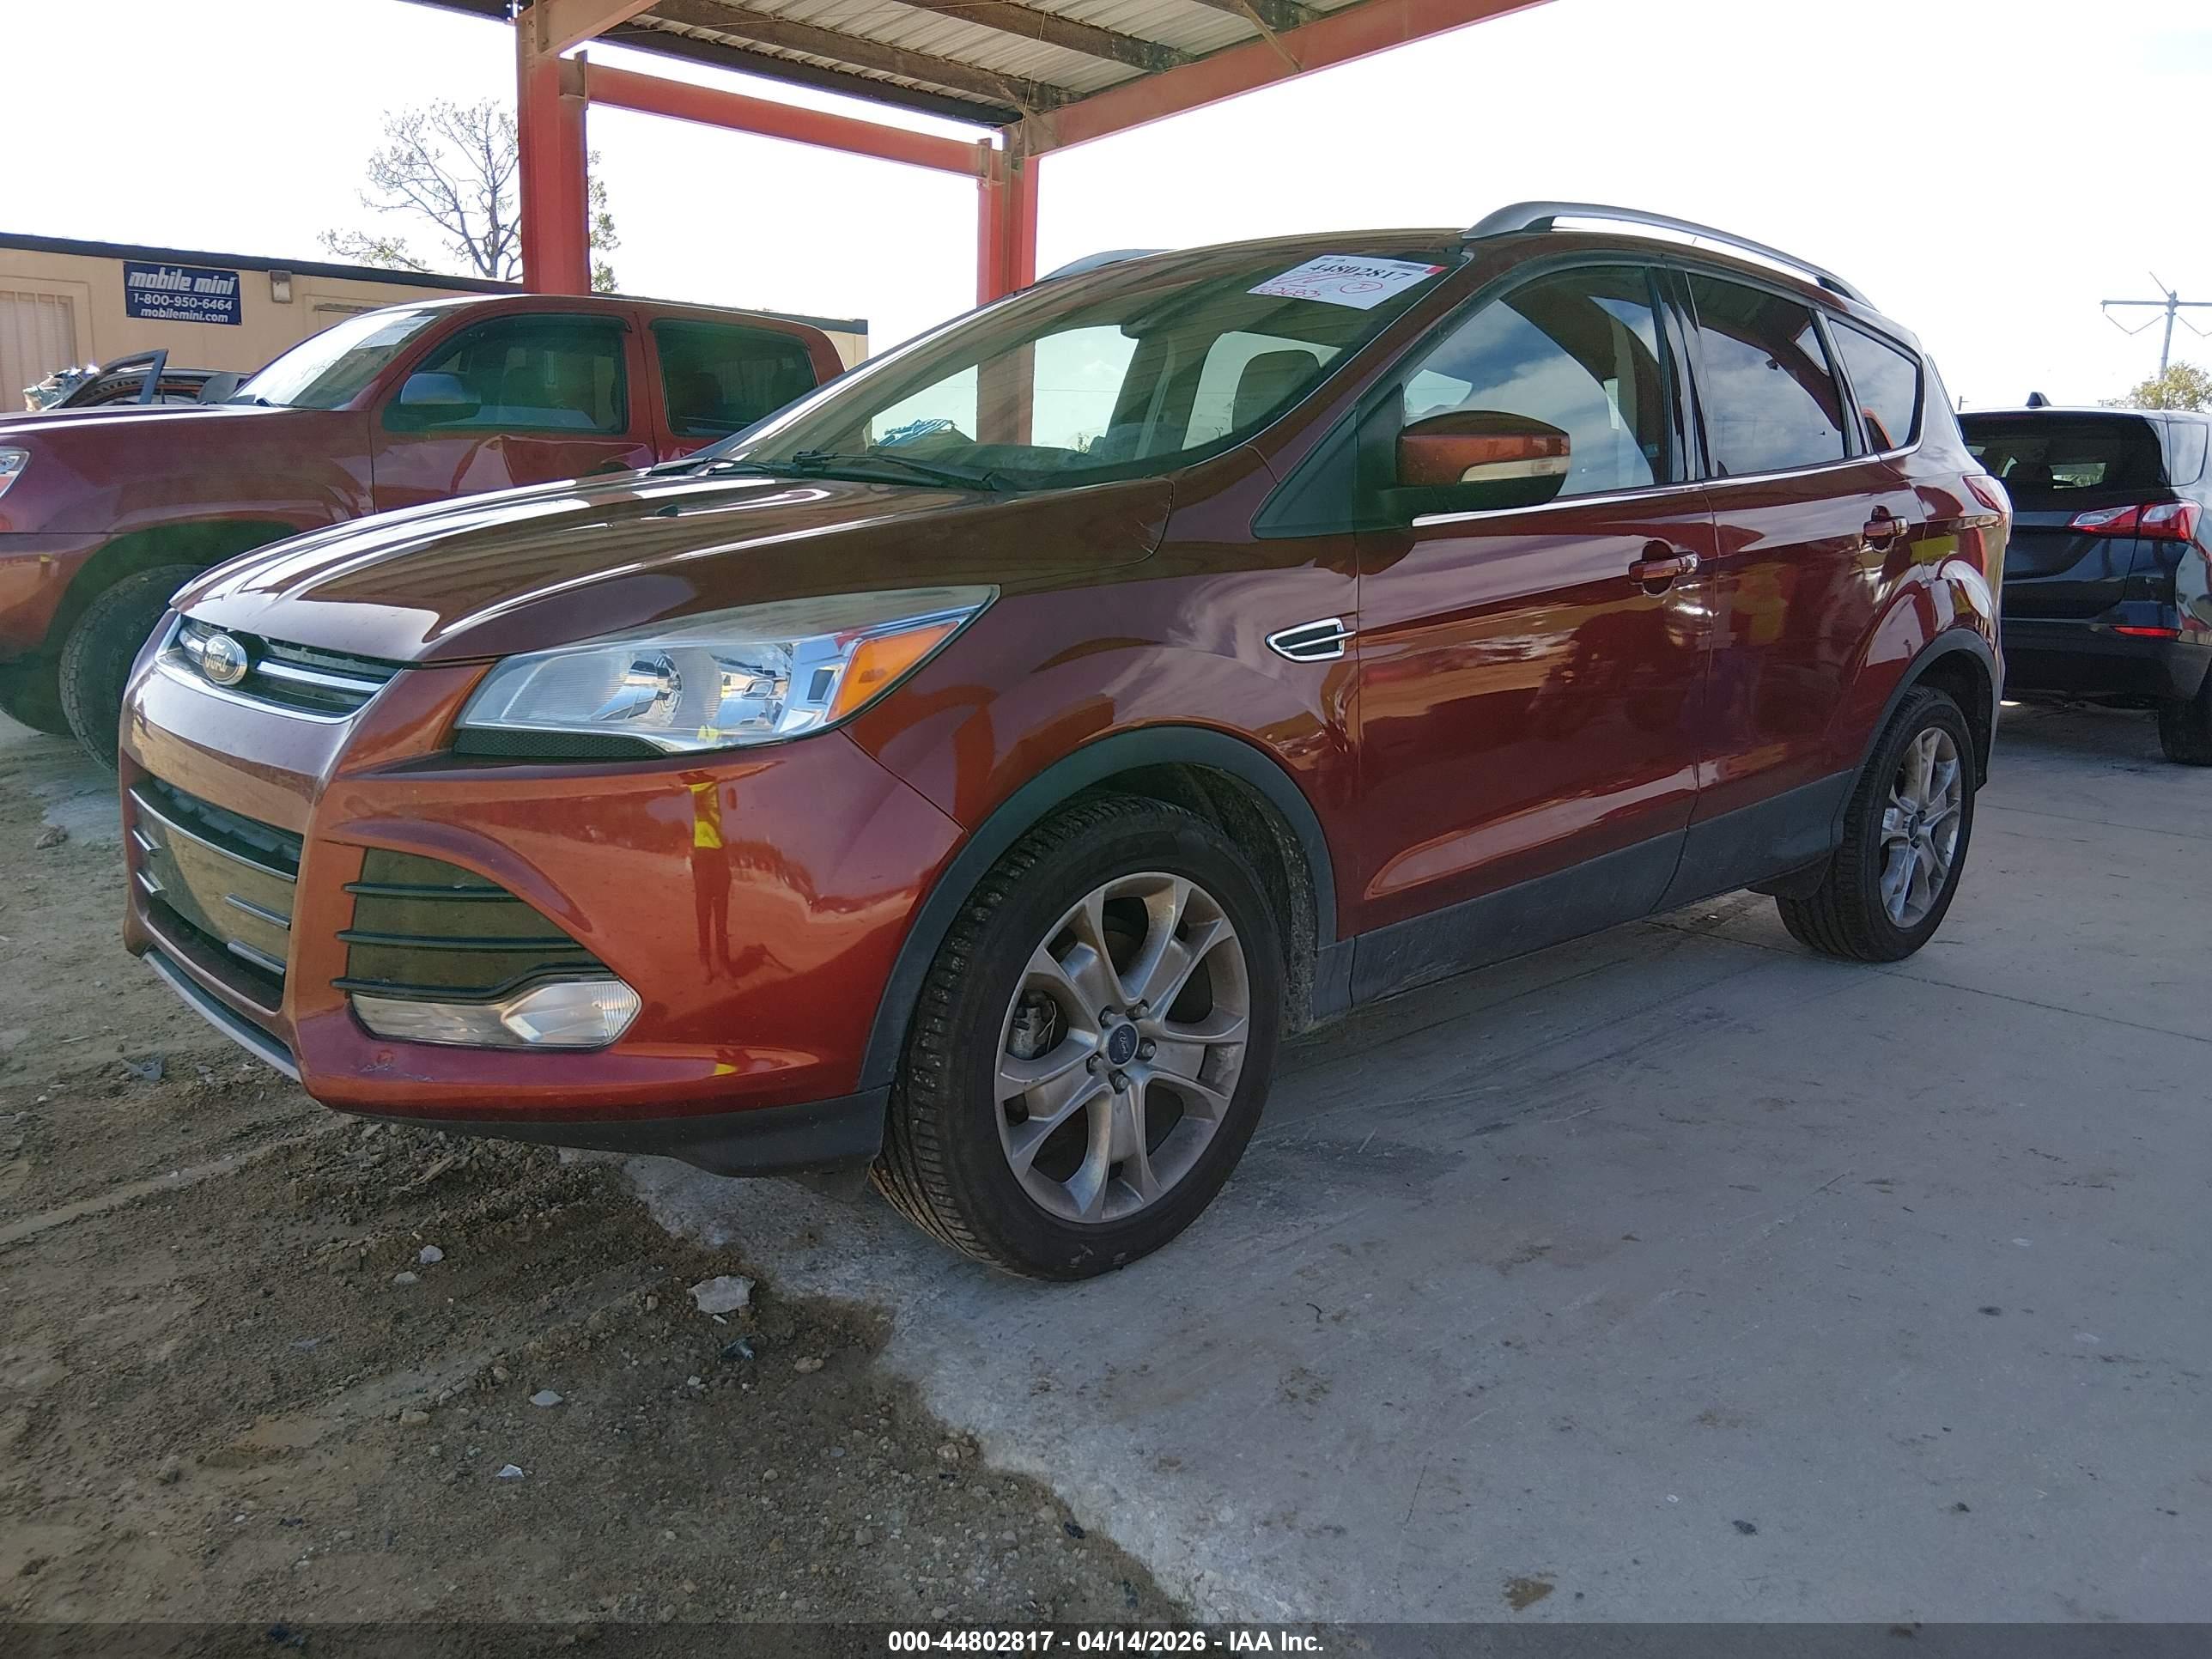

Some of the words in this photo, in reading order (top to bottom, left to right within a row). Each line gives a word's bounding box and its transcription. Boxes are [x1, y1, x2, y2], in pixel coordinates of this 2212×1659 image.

[128, 267, 192, 292] mobile
[193, 275, 238, 295] mini
[1309, 264, 1412, 282] 44802817
[133, 292, 233, 311] 1-800-950-6464
[140, 307, 228, 323] mobilemini.com
[205, 641, 230, 673] Ford
